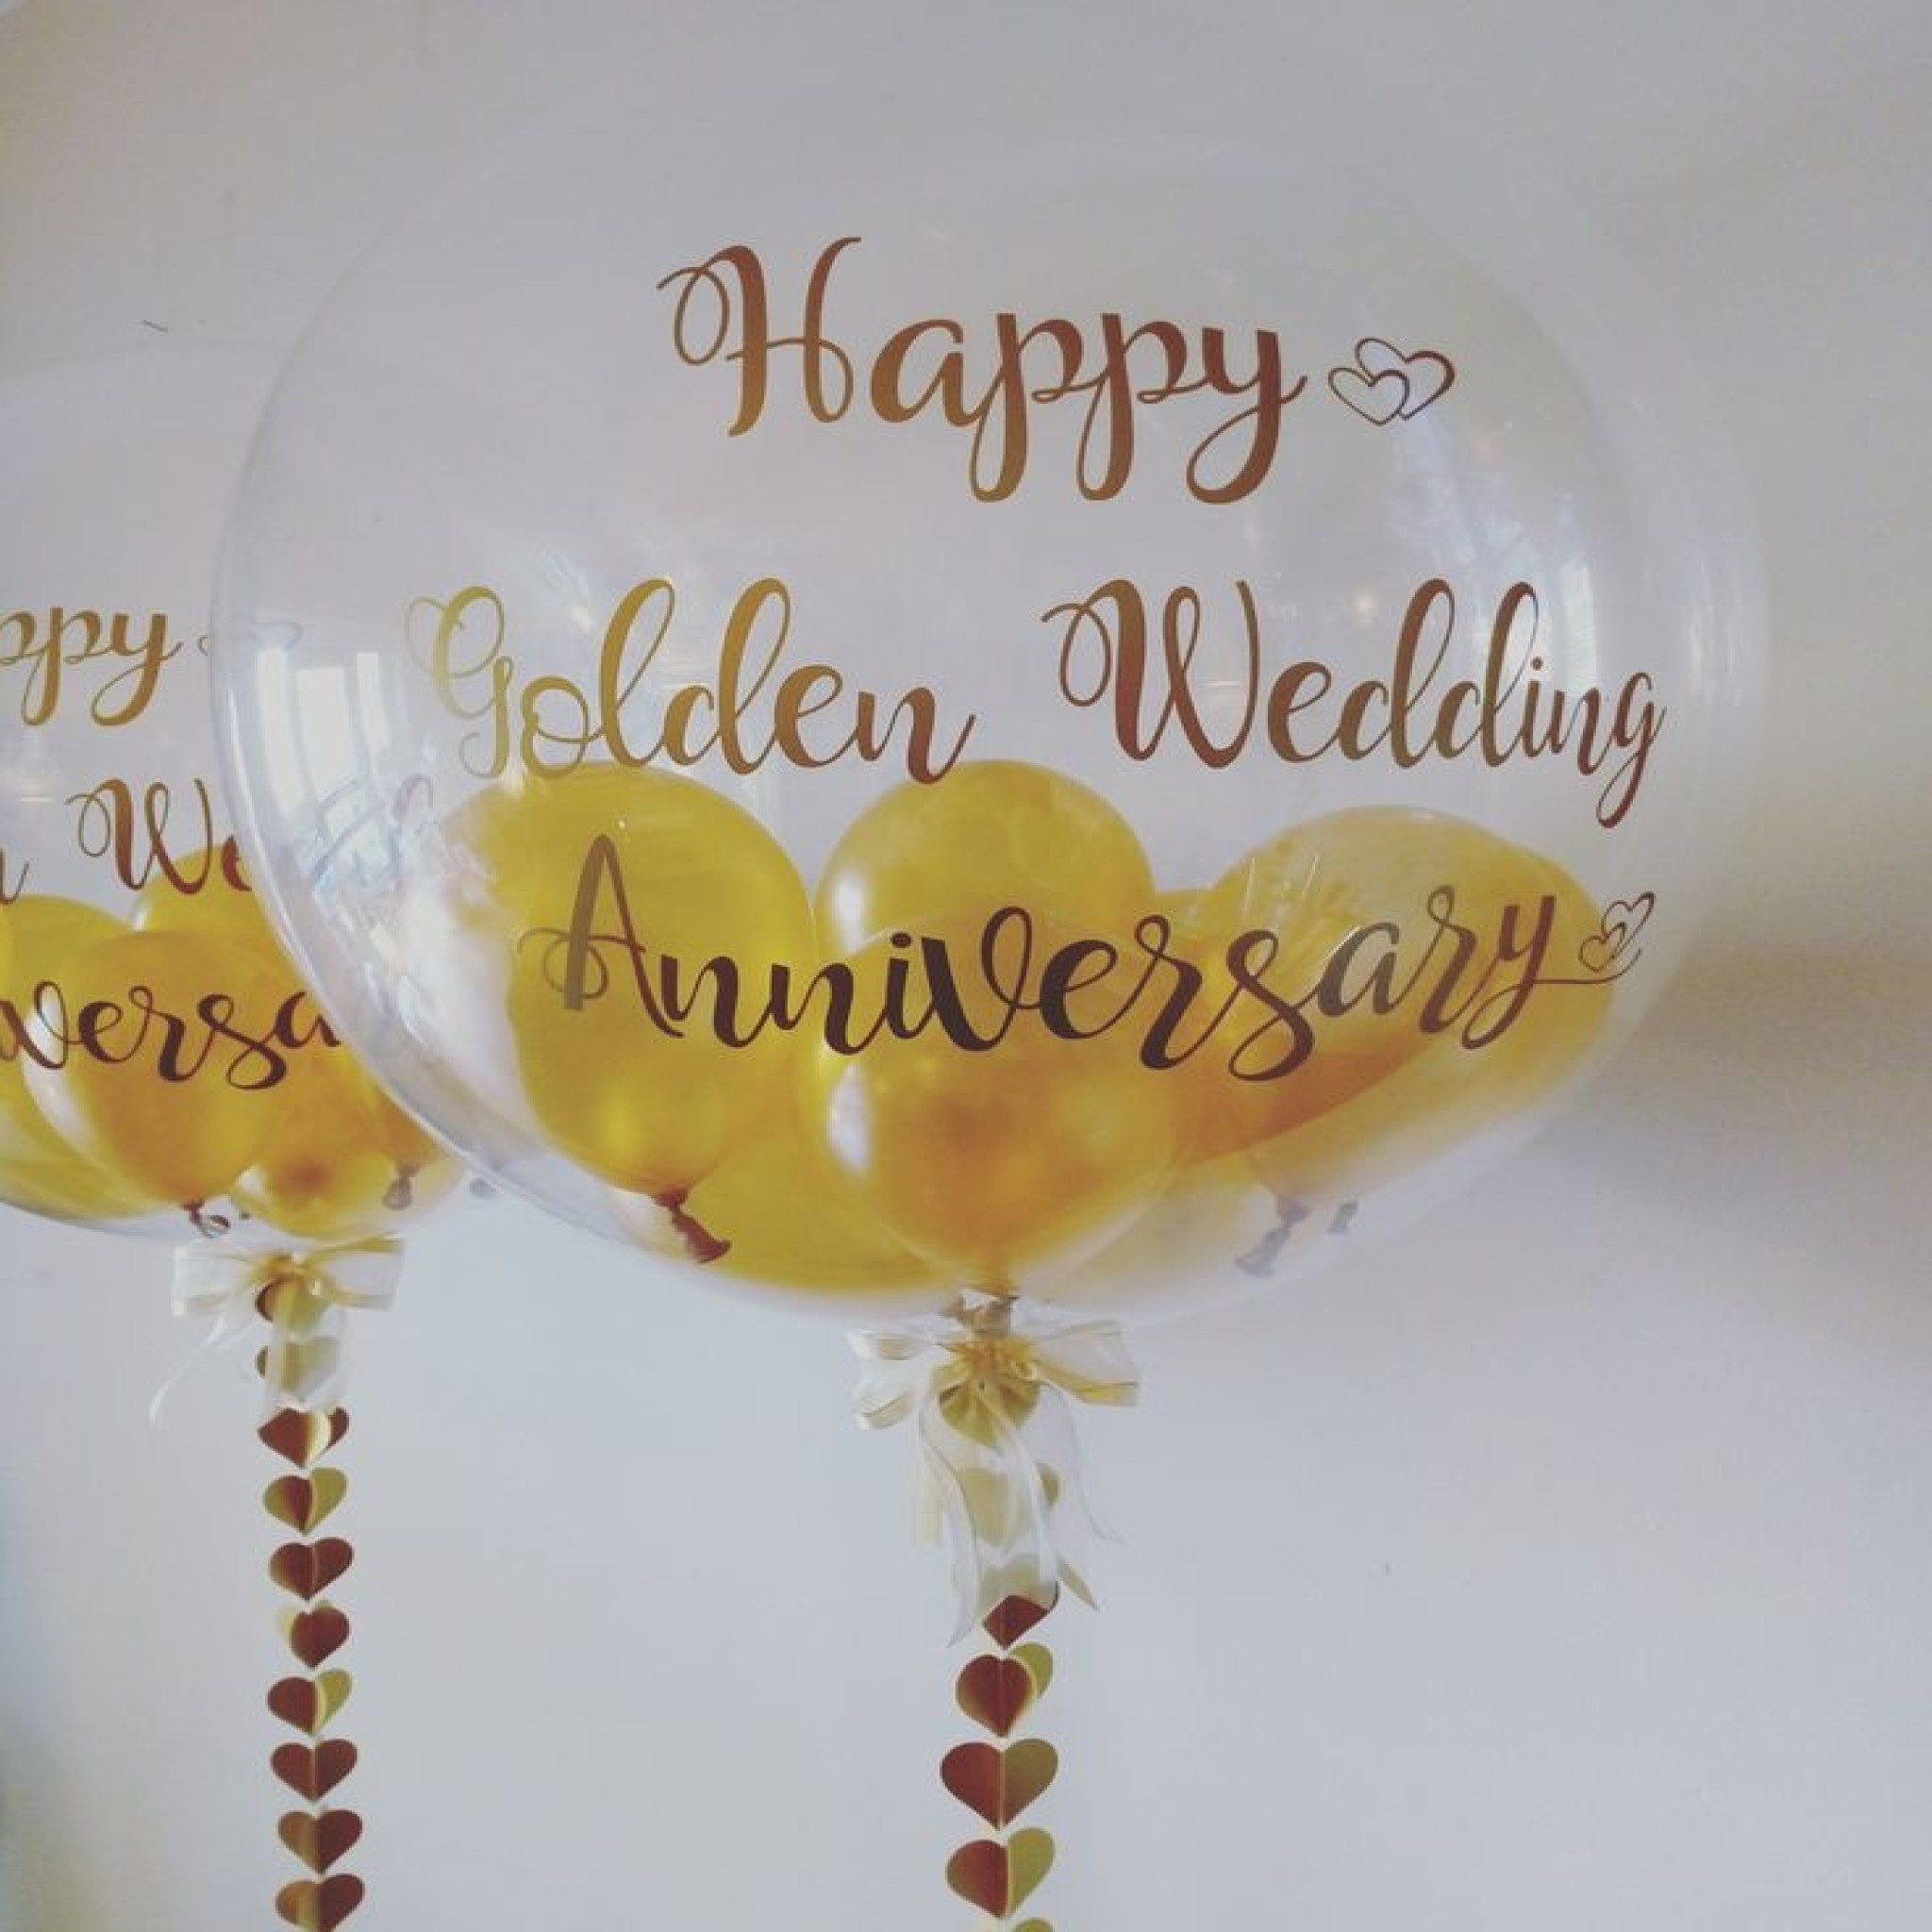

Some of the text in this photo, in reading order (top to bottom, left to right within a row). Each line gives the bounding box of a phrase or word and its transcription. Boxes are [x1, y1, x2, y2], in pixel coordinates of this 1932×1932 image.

[657, 236, 1307, 505] Happy
[405, 577, 1668, 828] Golden Wedding
[515, 834, 1604, 1082] Anniversary
